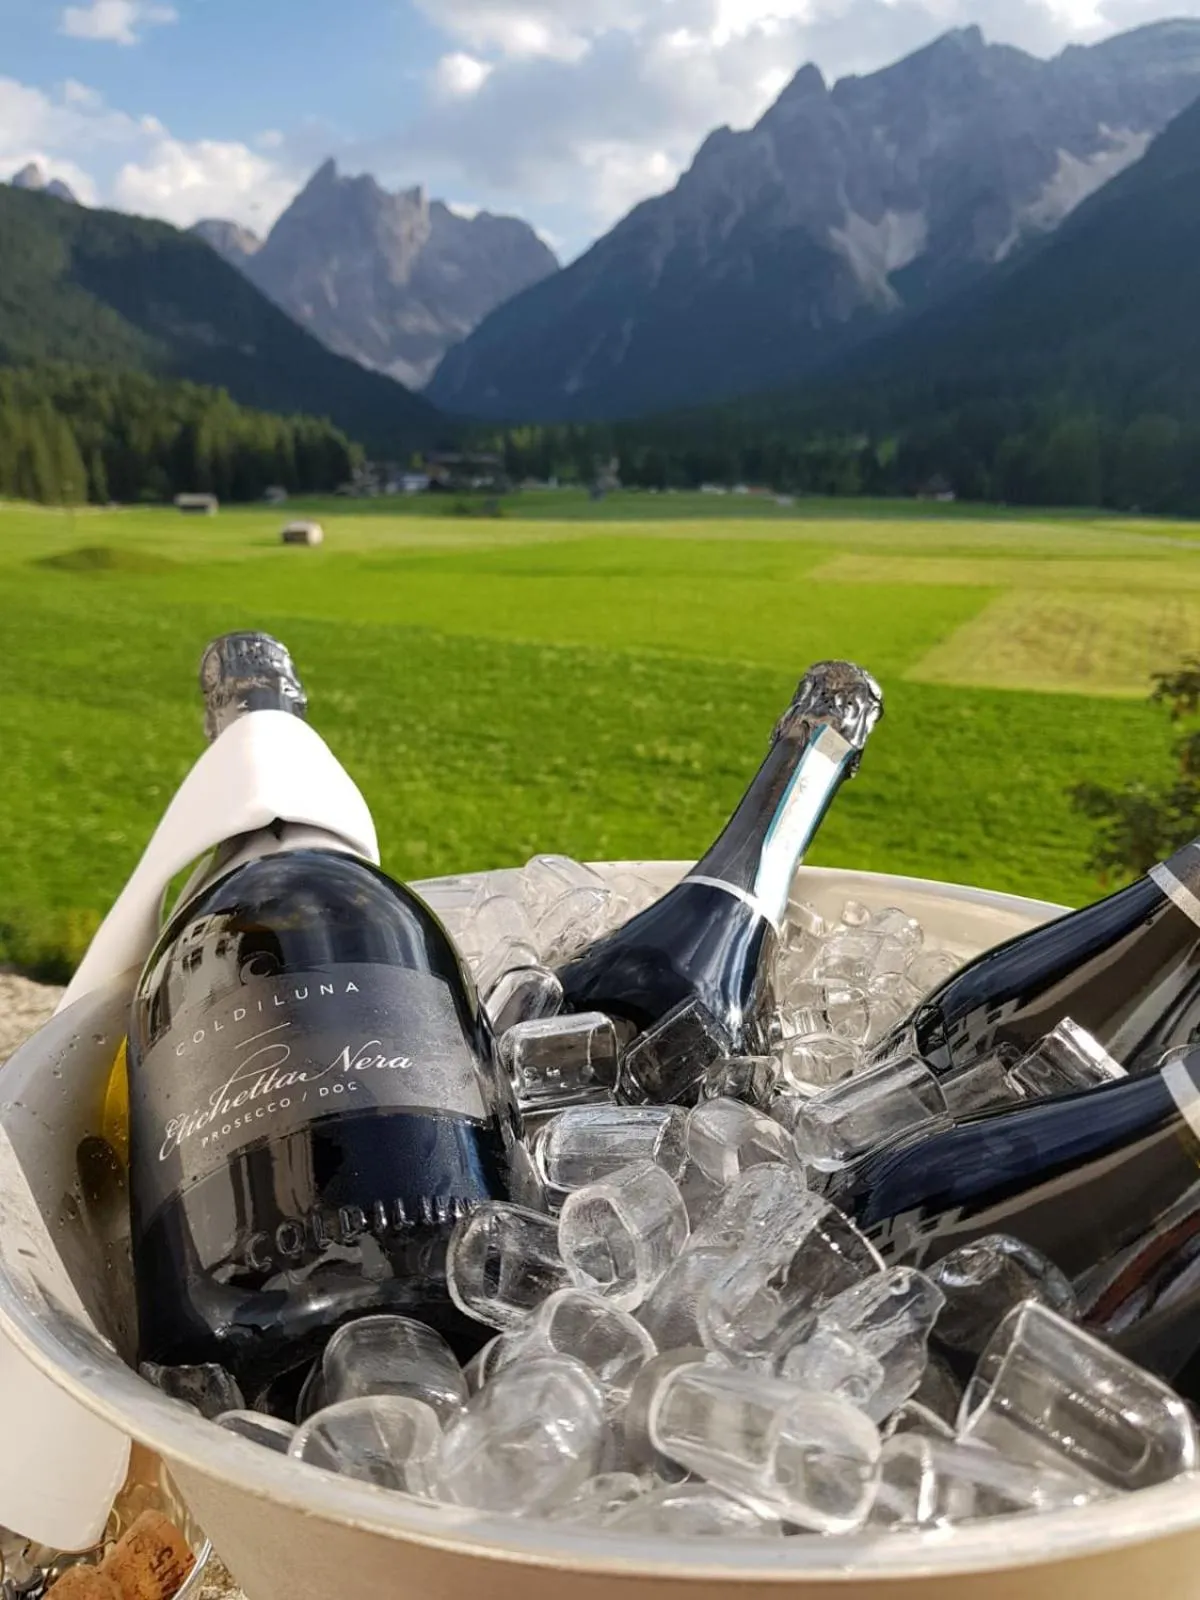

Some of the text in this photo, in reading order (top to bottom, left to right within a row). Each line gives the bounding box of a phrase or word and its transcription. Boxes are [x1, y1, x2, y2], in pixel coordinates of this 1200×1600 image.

[158, 1039, 413, 1162] Etichetta Nera
[201, 1097, 291, 1149] PROSECCO
[318, 1080, 358, 1098] DOC
